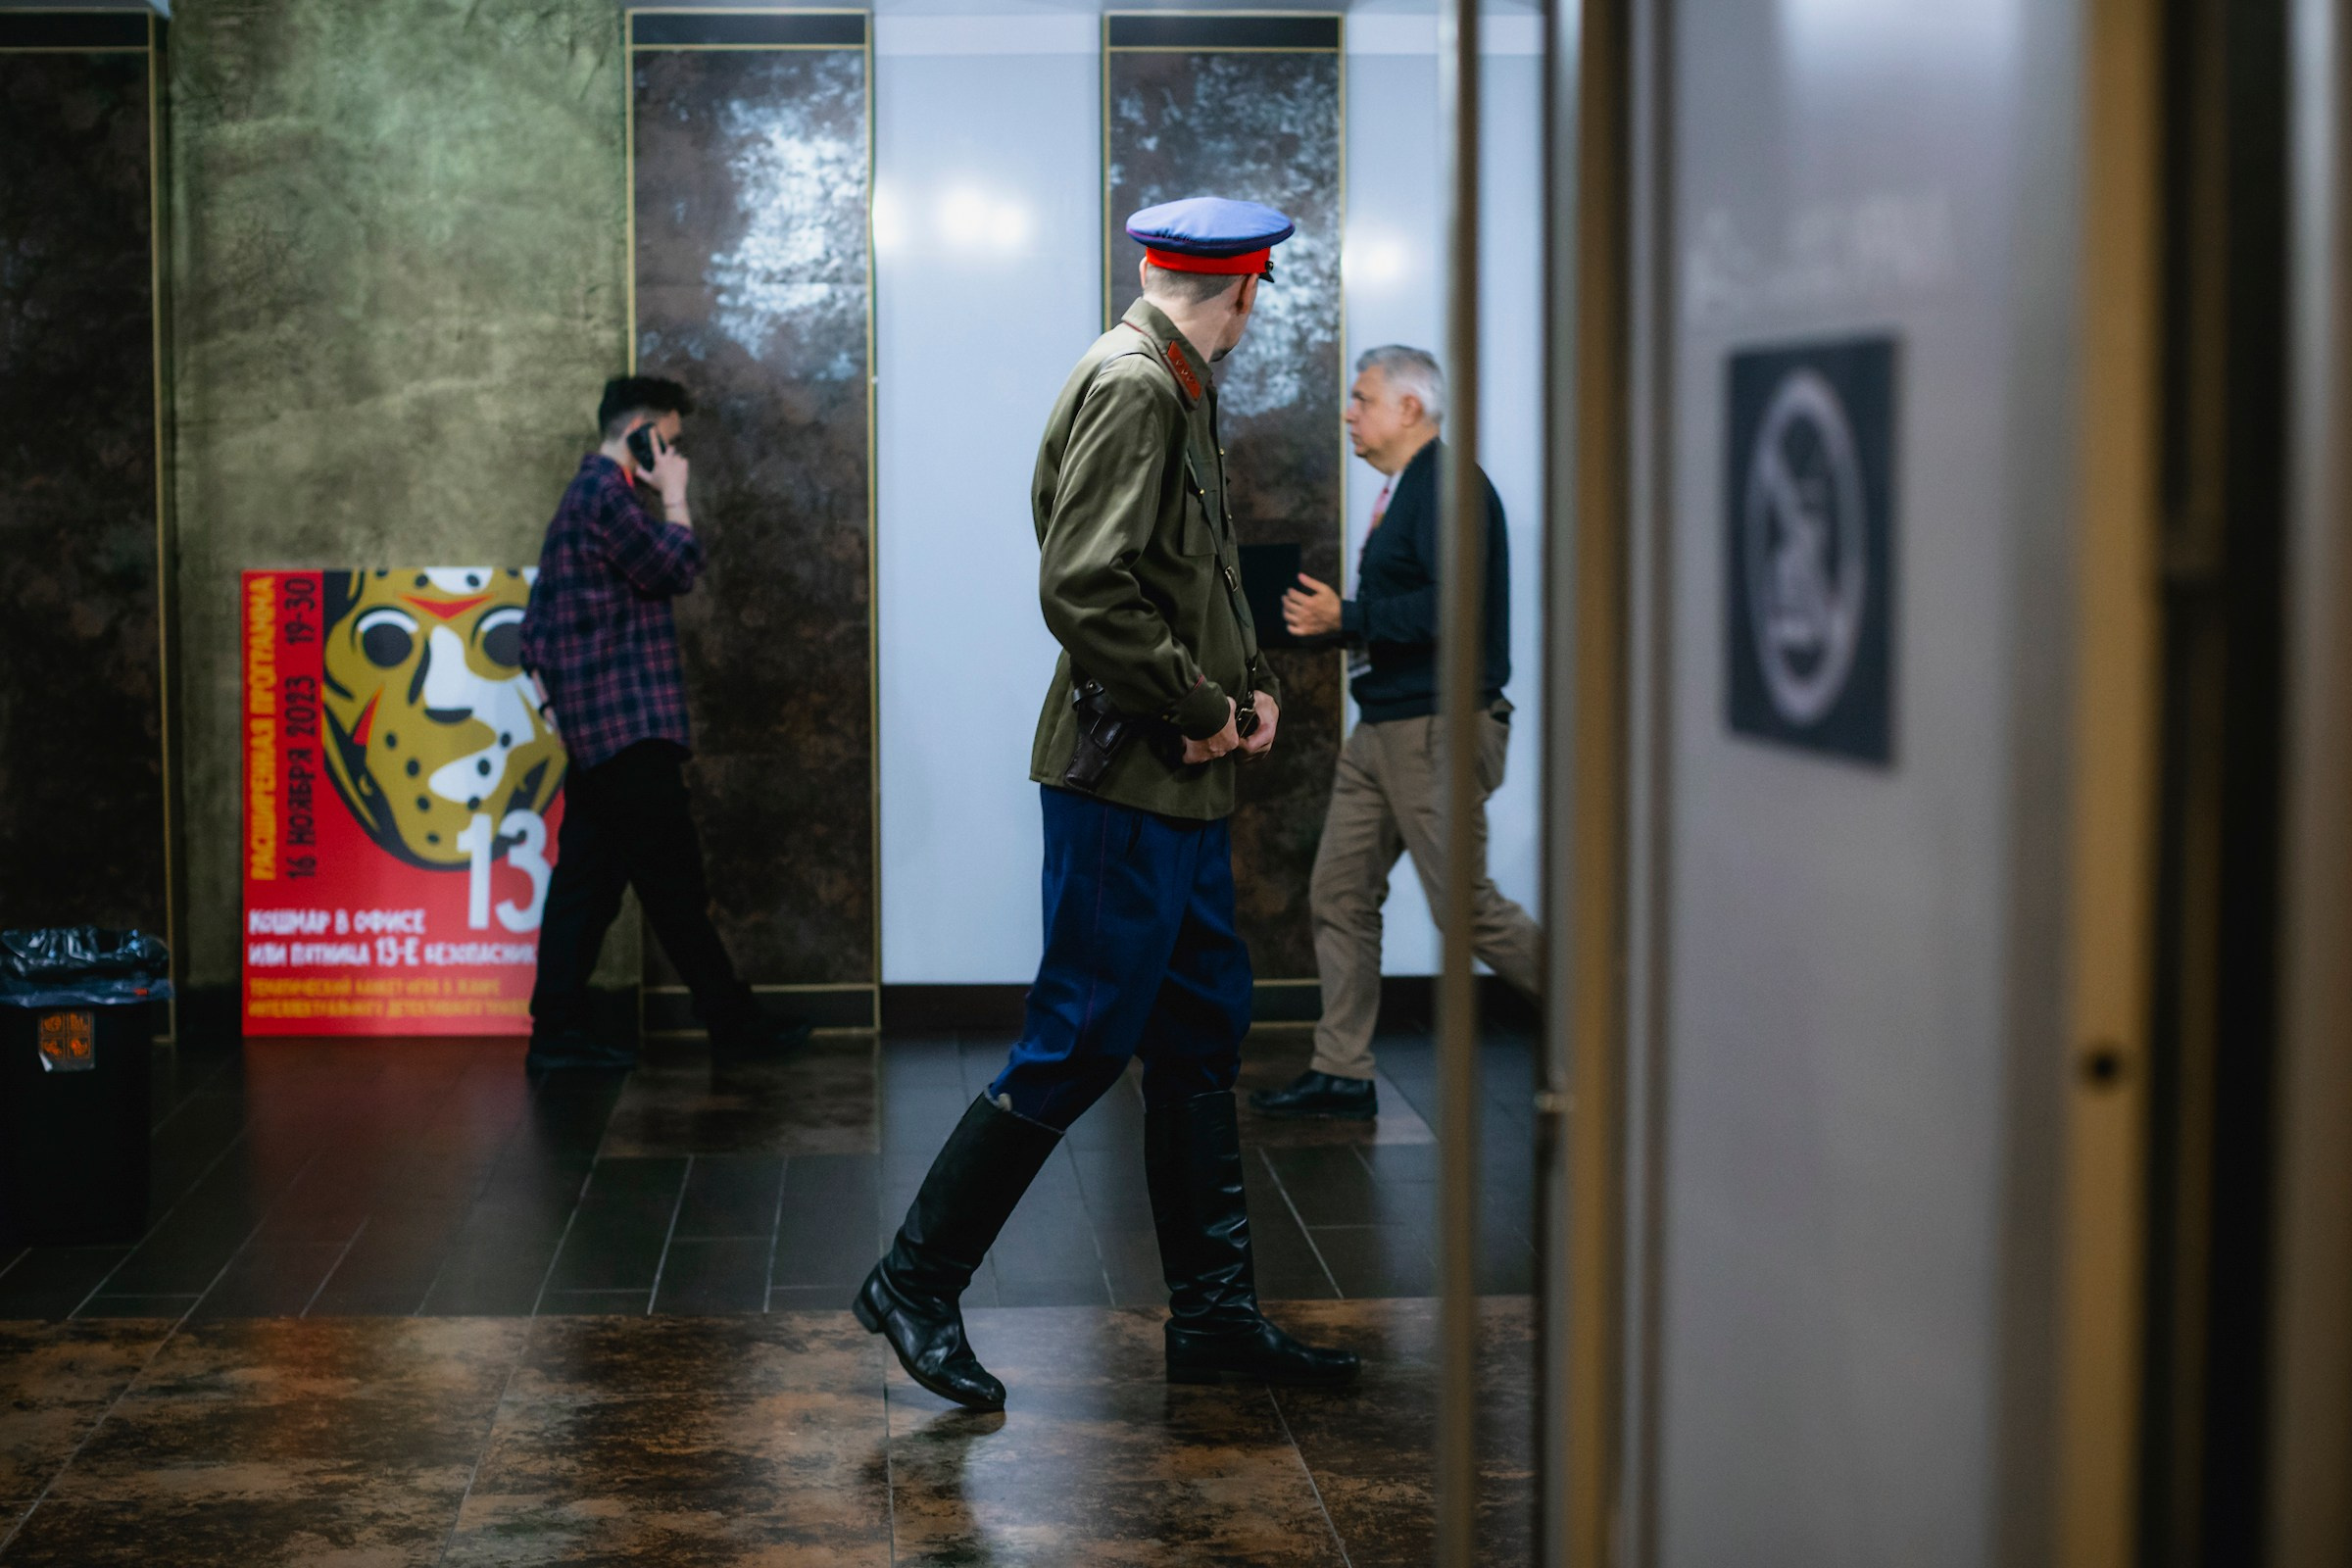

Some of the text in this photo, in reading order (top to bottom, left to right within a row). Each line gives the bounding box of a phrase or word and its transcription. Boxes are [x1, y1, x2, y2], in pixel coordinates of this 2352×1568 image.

[285, 577, 318, 647] 19-30
[286, 747, 318, 849] НОЯБРЯ
[286, 855, 318, 880] 16
[457, 809, 551, 933] 13
[248, 907, 425, 935] КОШМАР В ОФИСЕ
[248, 942, 287, 966] ИЛИ
